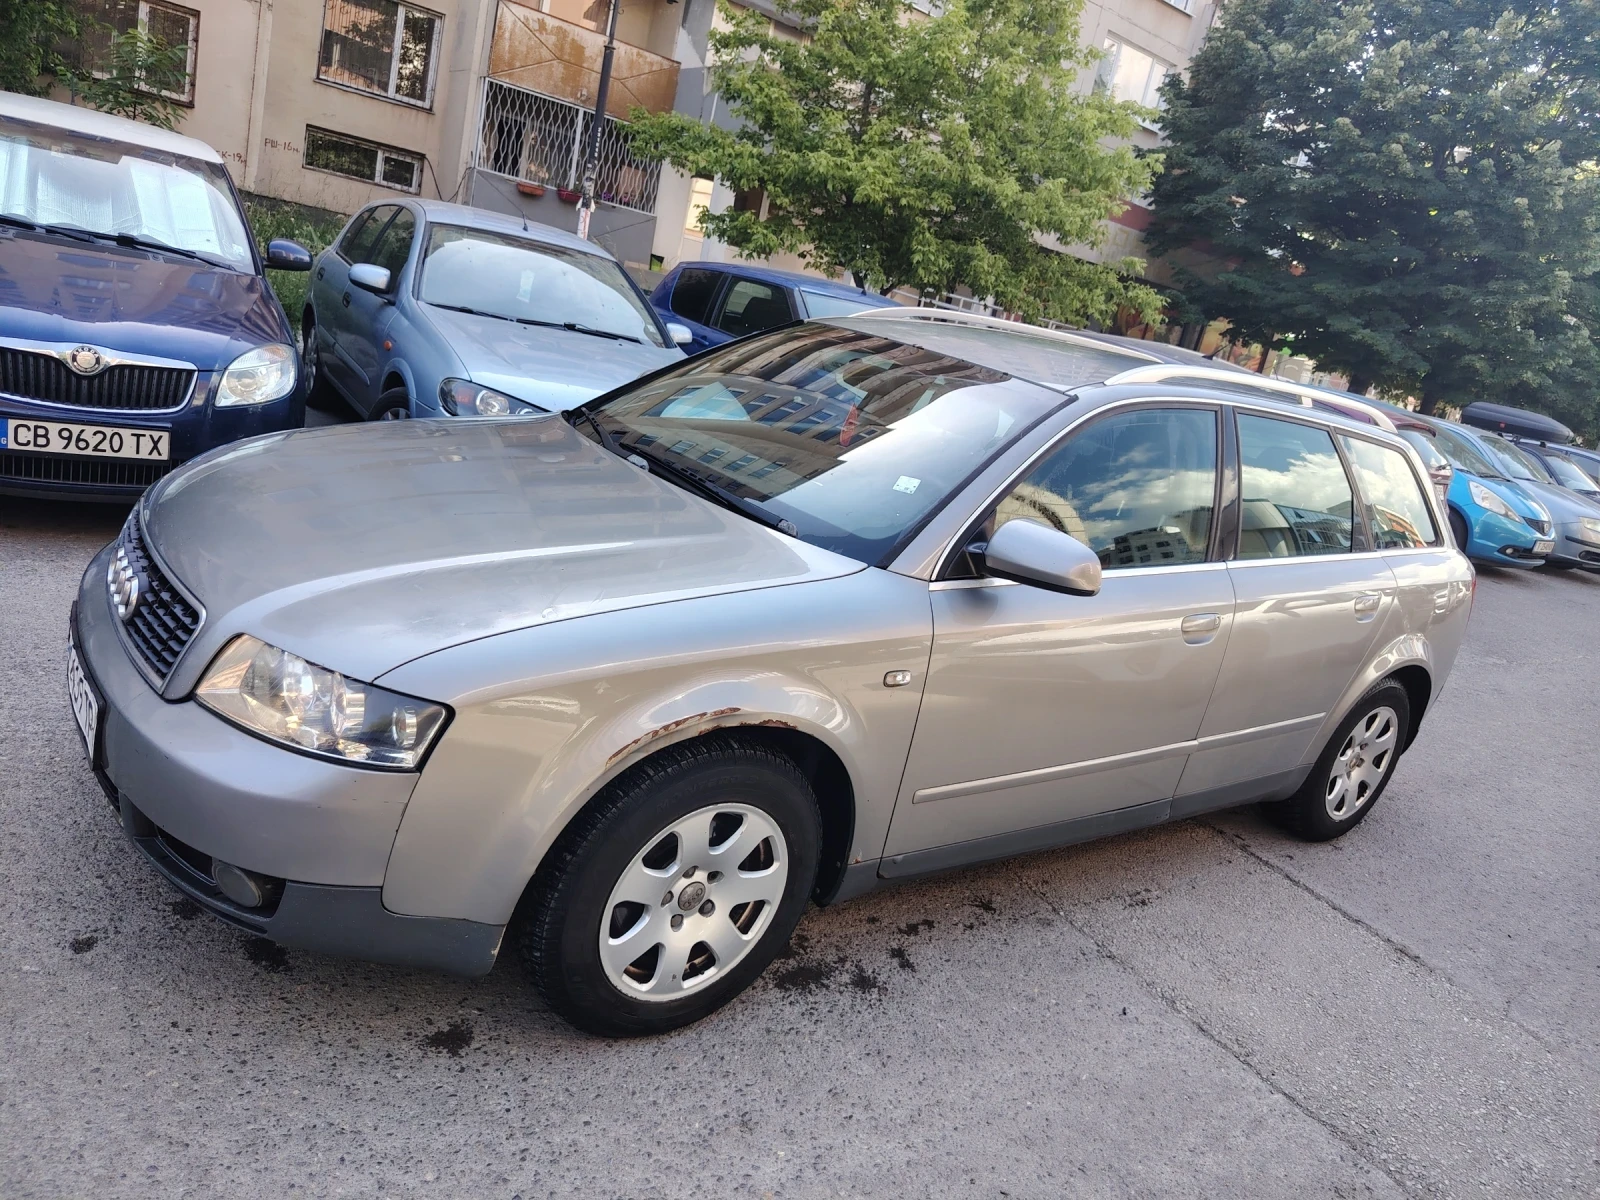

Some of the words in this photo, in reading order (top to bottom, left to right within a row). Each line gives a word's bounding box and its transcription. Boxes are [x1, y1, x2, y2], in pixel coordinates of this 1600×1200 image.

[13, 423, 51, 448] CB
[57, 427, 124, 454] 9620
[130, 432, 164, 457] TX
